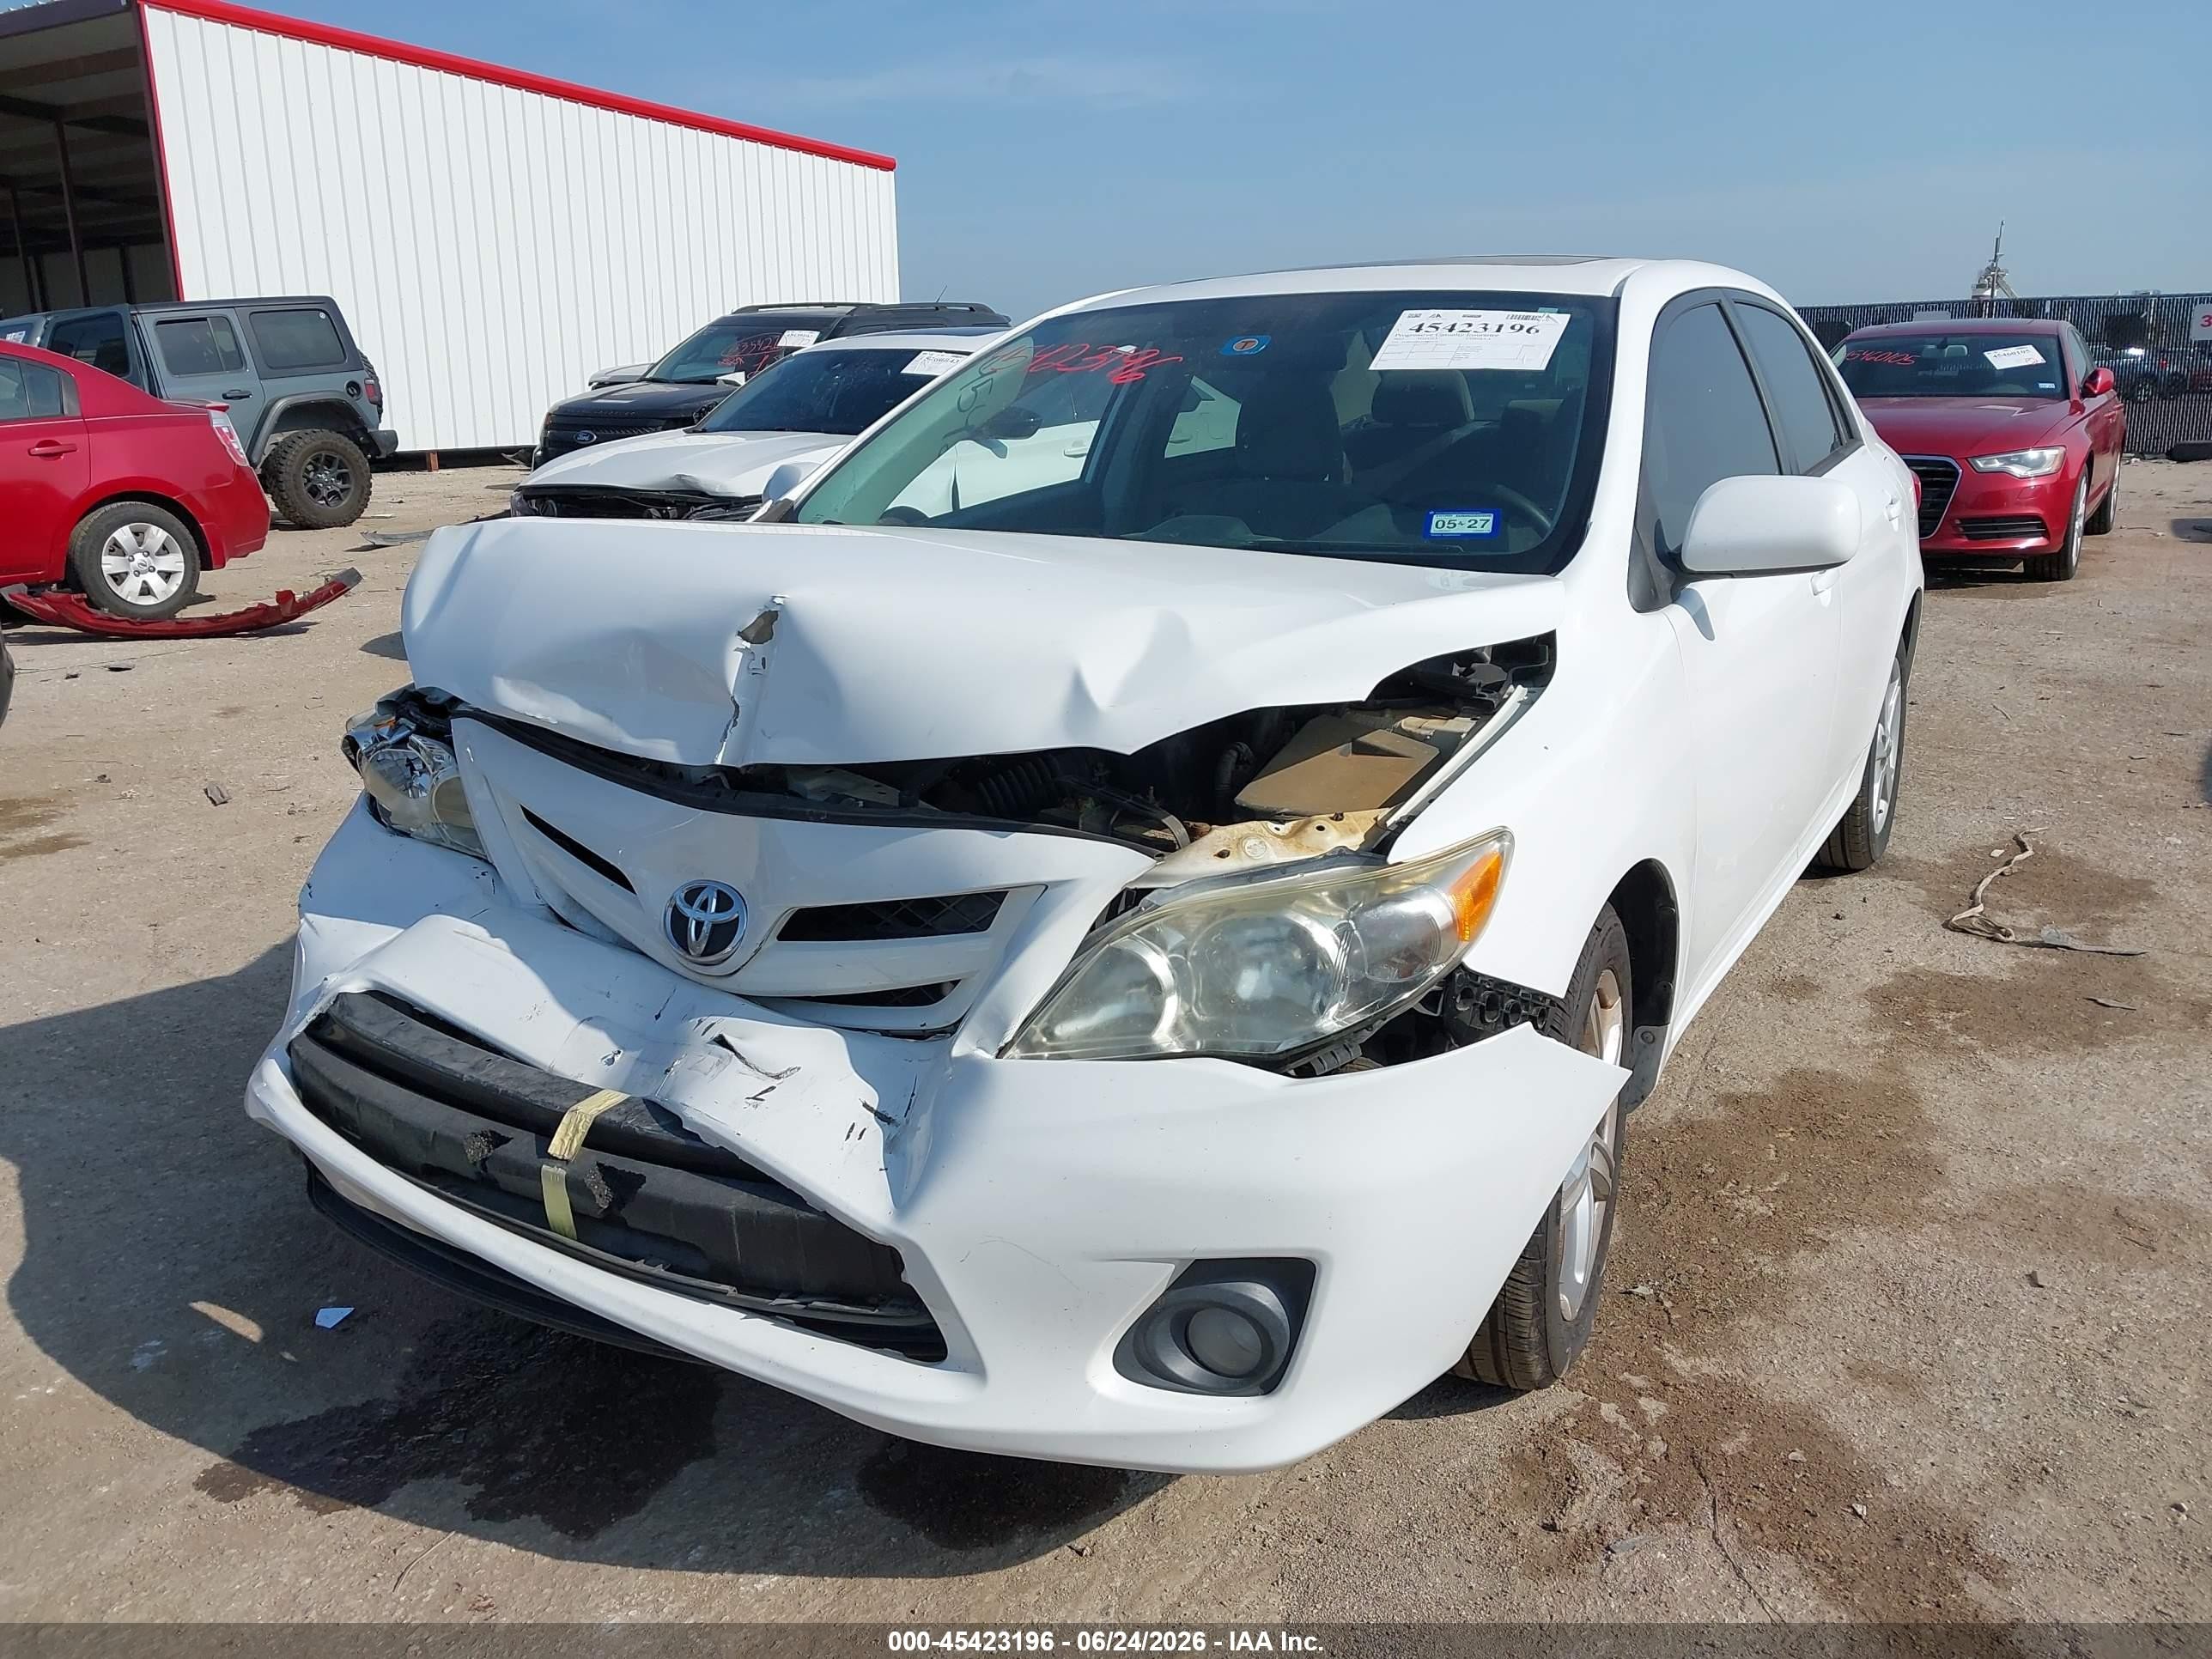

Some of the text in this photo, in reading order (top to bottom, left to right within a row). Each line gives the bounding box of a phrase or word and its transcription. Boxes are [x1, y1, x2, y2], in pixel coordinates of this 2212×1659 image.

[1408, 321, 1540, 336] 45423196
[1435, 519, 1491, 529] 05 27
